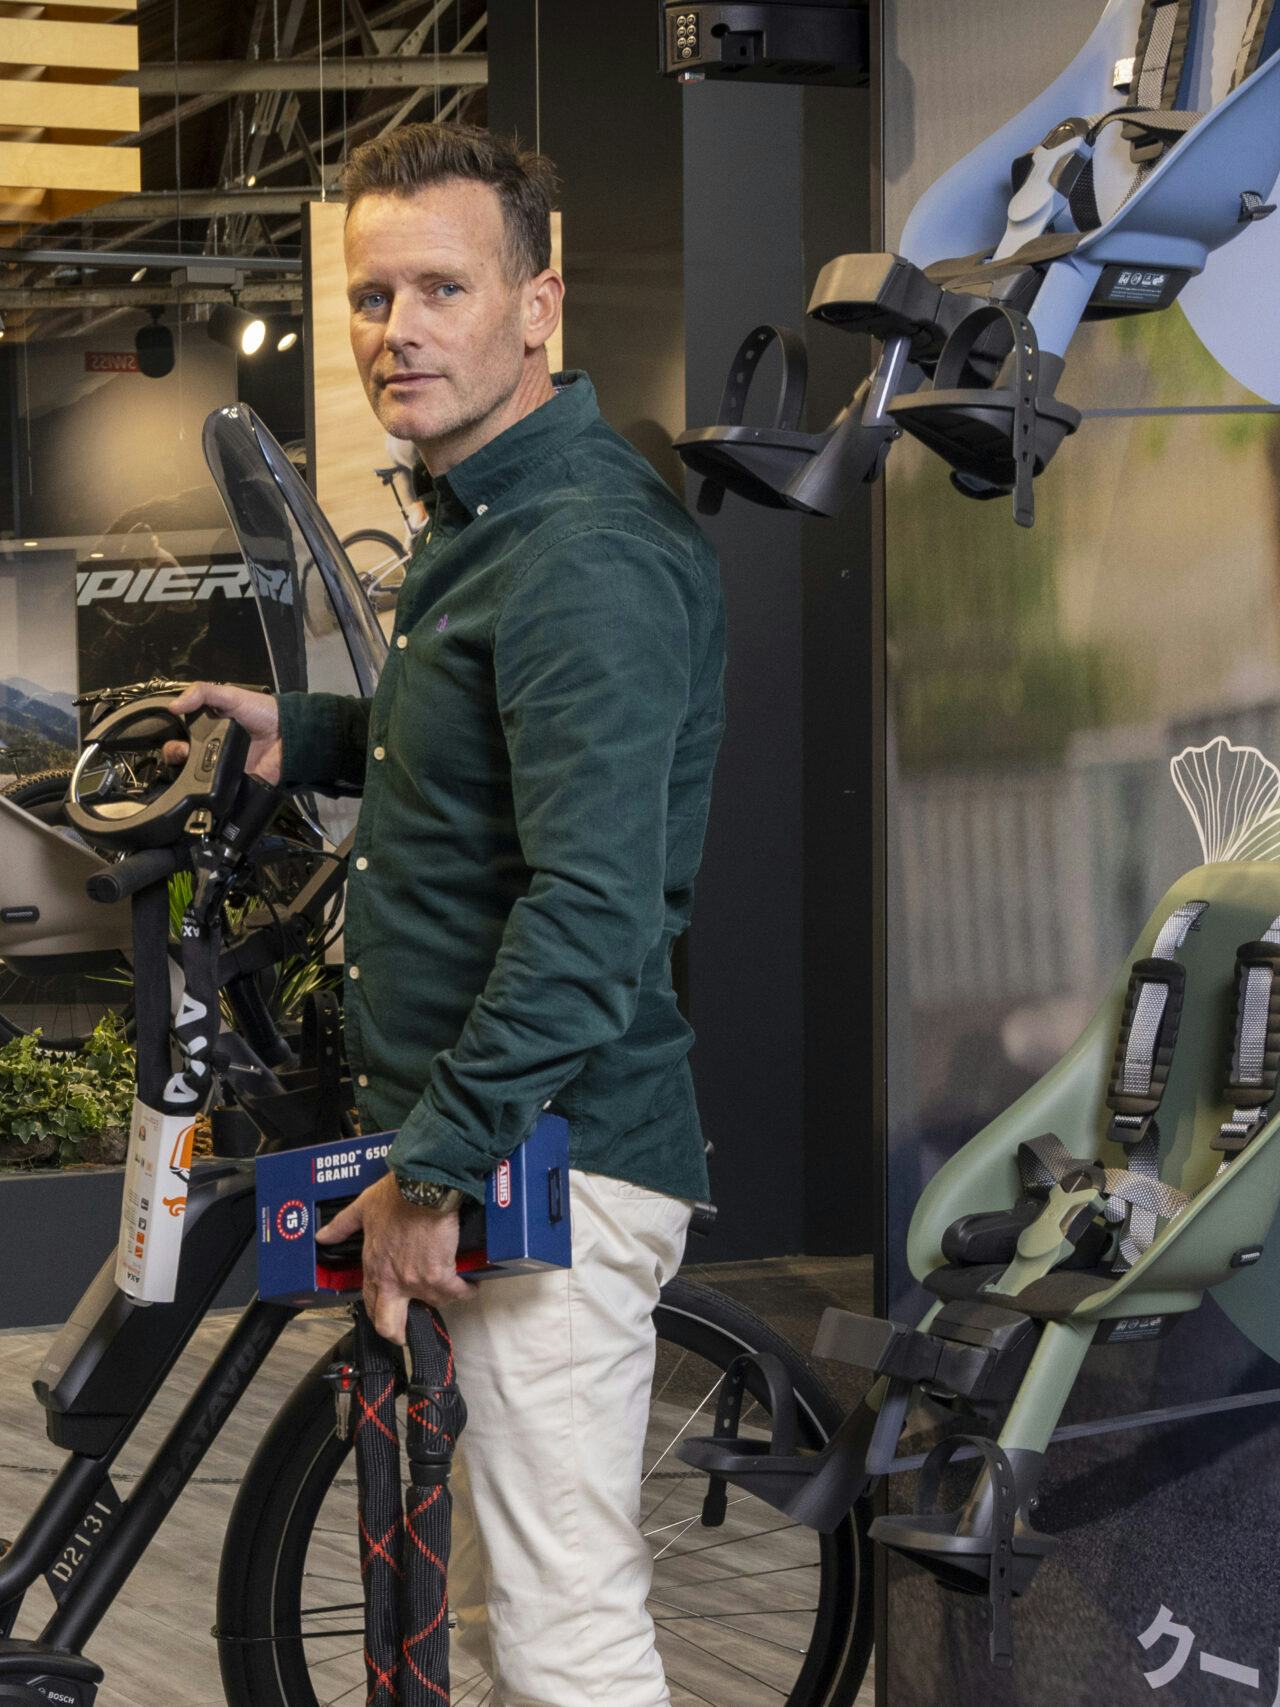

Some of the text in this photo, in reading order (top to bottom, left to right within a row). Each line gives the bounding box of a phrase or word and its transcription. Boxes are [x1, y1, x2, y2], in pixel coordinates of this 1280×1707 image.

[316, 1165, 362, 1184] GRANIT
[500, 1164, 508, 1202] ABUS
[286, 1210, 298, 1229] 15
[48, 1690, 76, 1705] BOSCH
